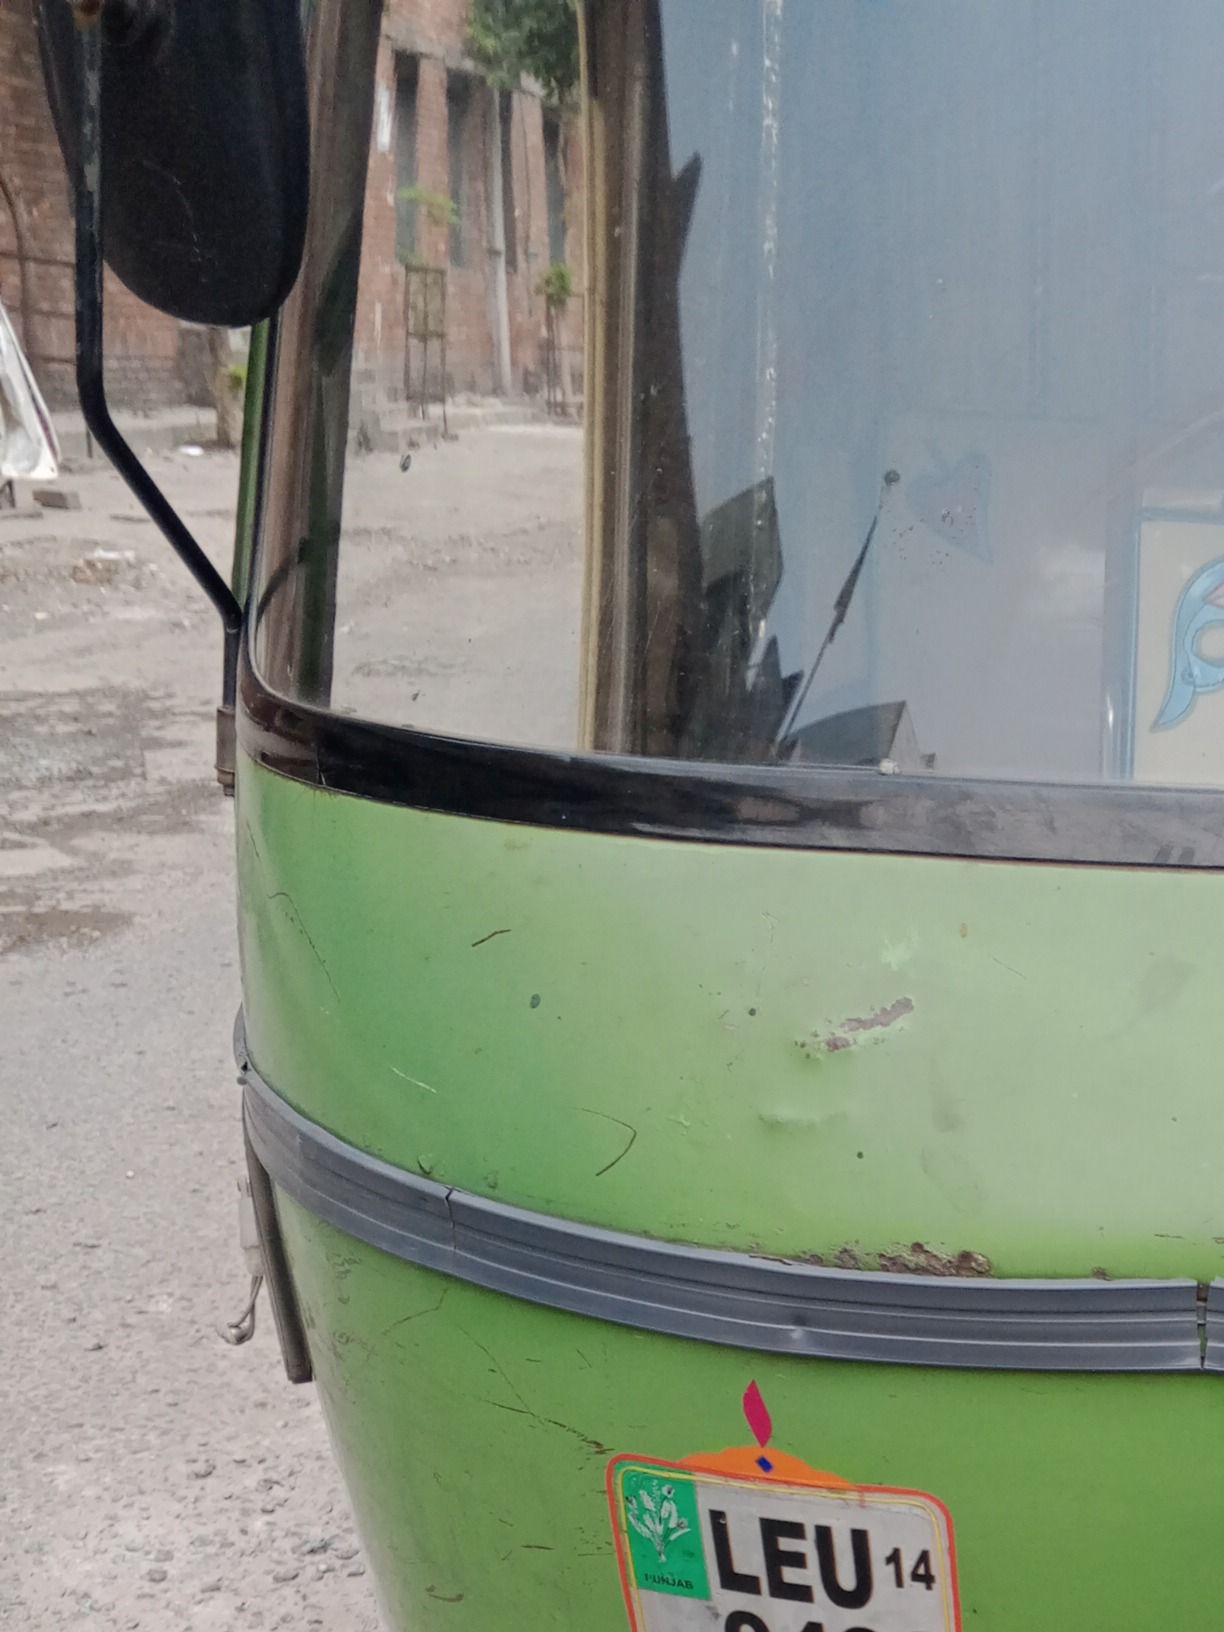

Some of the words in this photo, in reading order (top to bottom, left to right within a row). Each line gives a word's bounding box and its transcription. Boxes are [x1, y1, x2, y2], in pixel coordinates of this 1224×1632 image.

[643, 1572, 695, 1591] PUNJAB
[708, 1509, 874, 1610] LEU
[885, 1546, 936, 1591] 14
